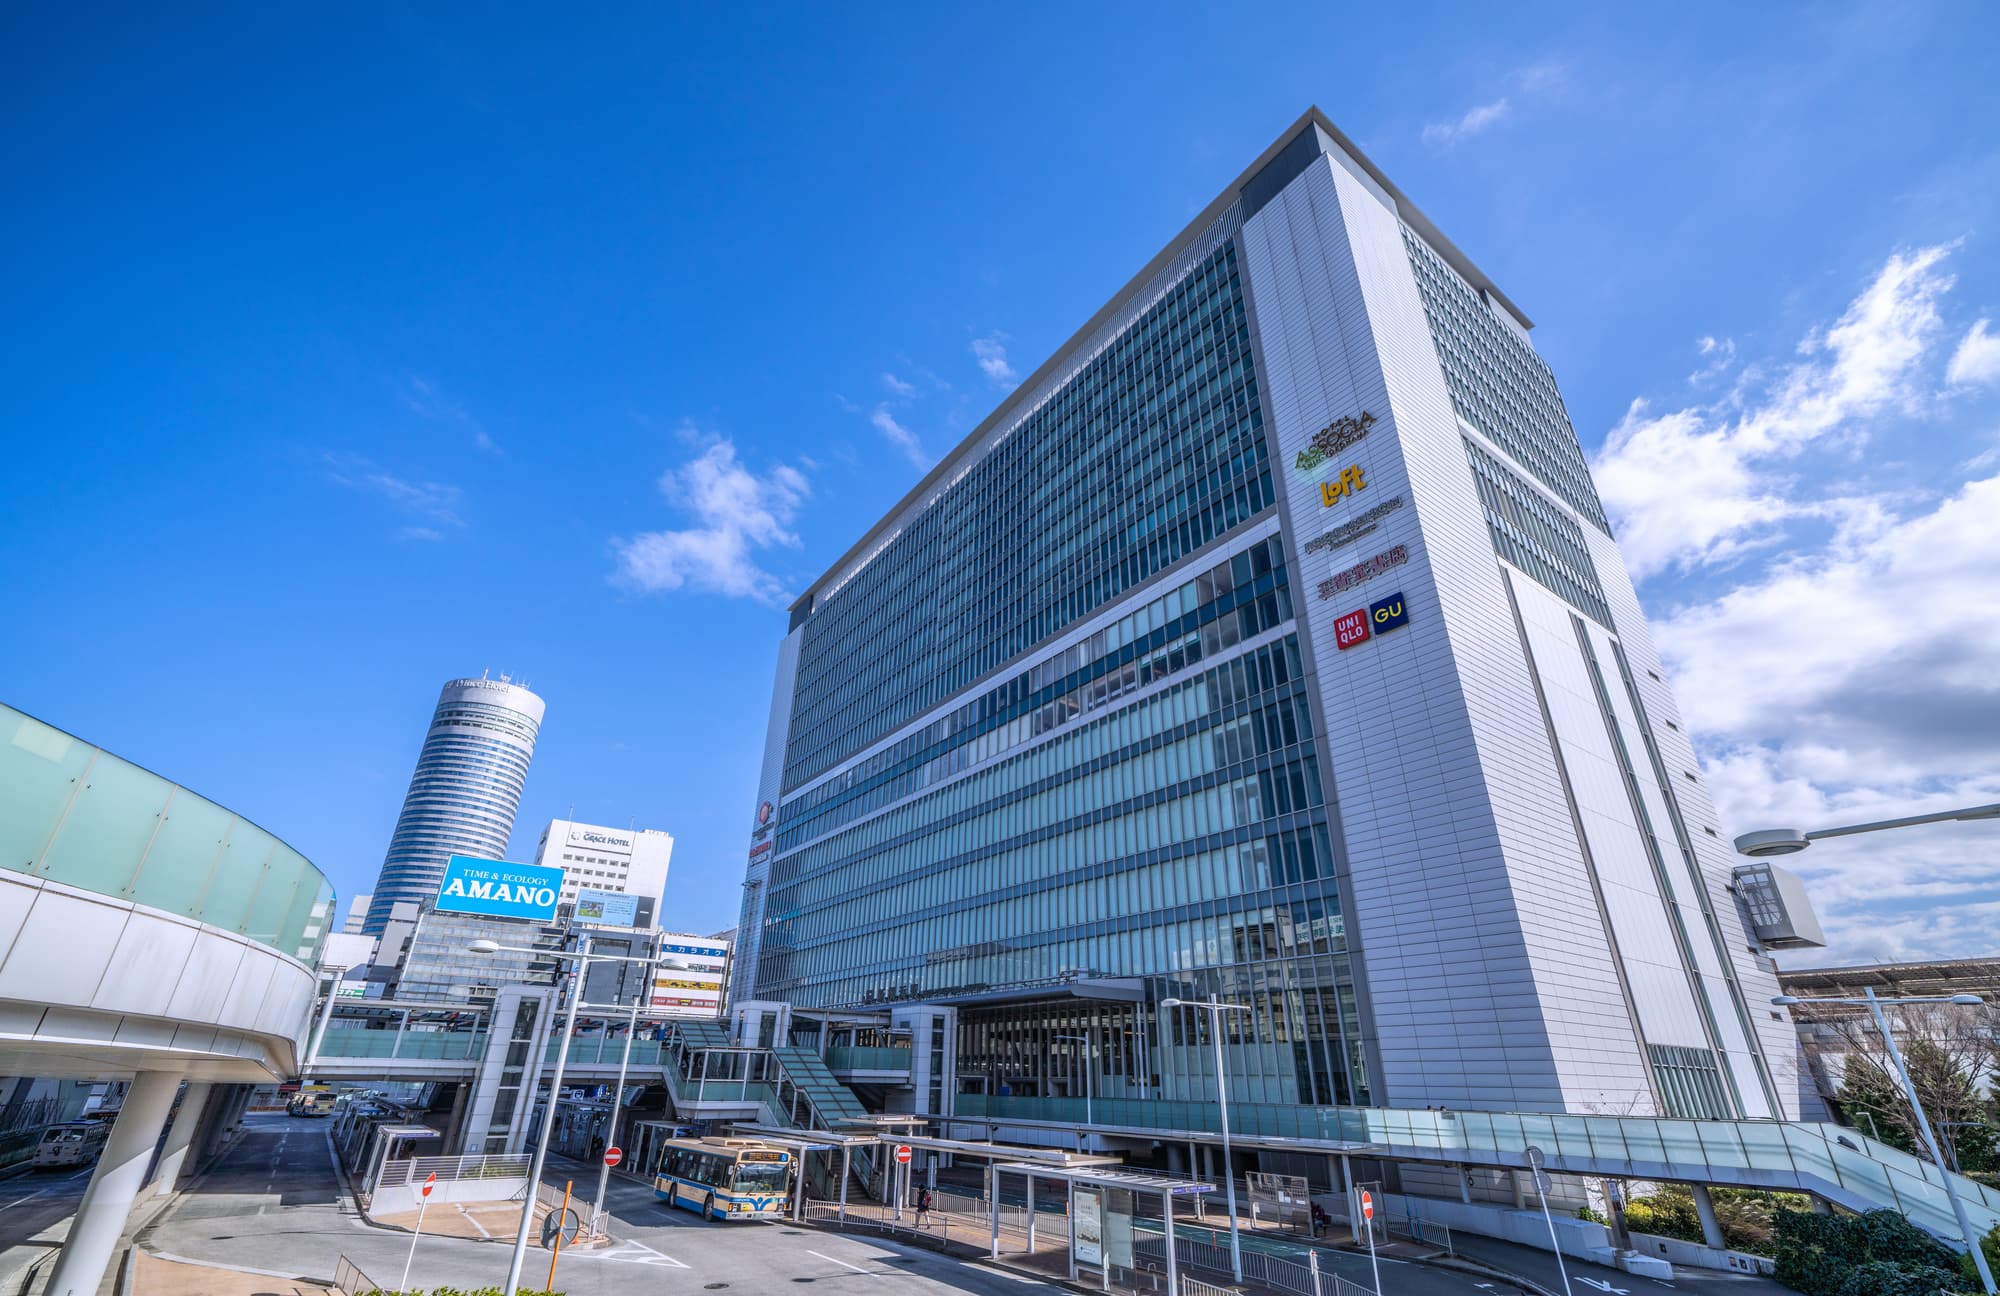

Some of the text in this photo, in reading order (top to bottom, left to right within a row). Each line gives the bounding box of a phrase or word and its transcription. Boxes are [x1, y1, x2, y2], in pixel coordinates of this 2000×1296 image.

[1311, 415, 1351, 443] HOTEL
[1295, 410, 1377, 470] ASSOCIA
[1374, 602, 1402, 623] GU
[1338, 614, 1359, 632] UNI
[1340, 625, 1364, 645] QLO
[607, 836, 630, 847] HOTEL
[463, 868, 549, 886] TIME & ECOLOGY
[443, 877, 556, 907] AMANO
